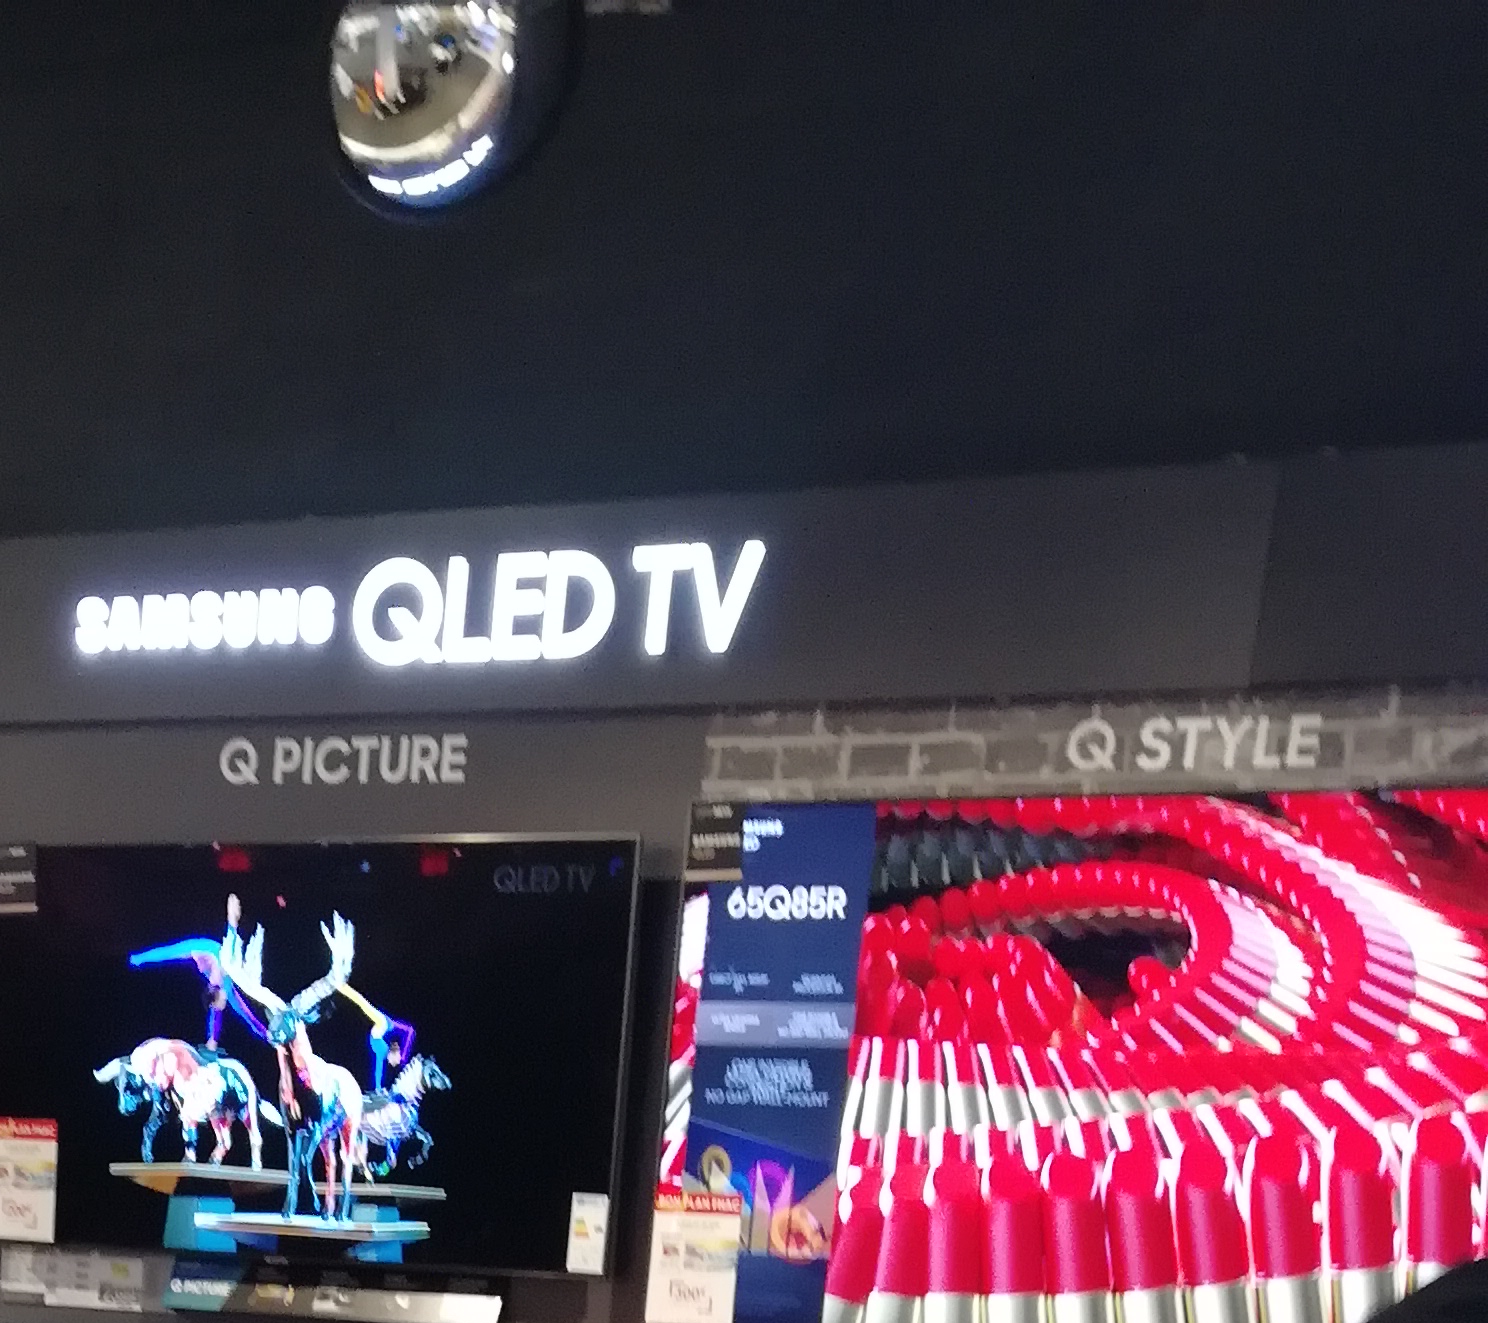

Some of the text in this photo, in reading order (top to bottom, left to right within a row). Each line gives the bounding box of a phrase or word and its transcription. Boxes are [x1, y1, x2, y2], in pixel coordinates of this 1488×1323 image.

[74, 538, 768, 667] SAMSUNG QLED TV
[219, 732, 469, 786] Q PICTURE
[1066, 713, 1323, 772] Q STYLE
[726, 884, 848, 920] 65Q85R
